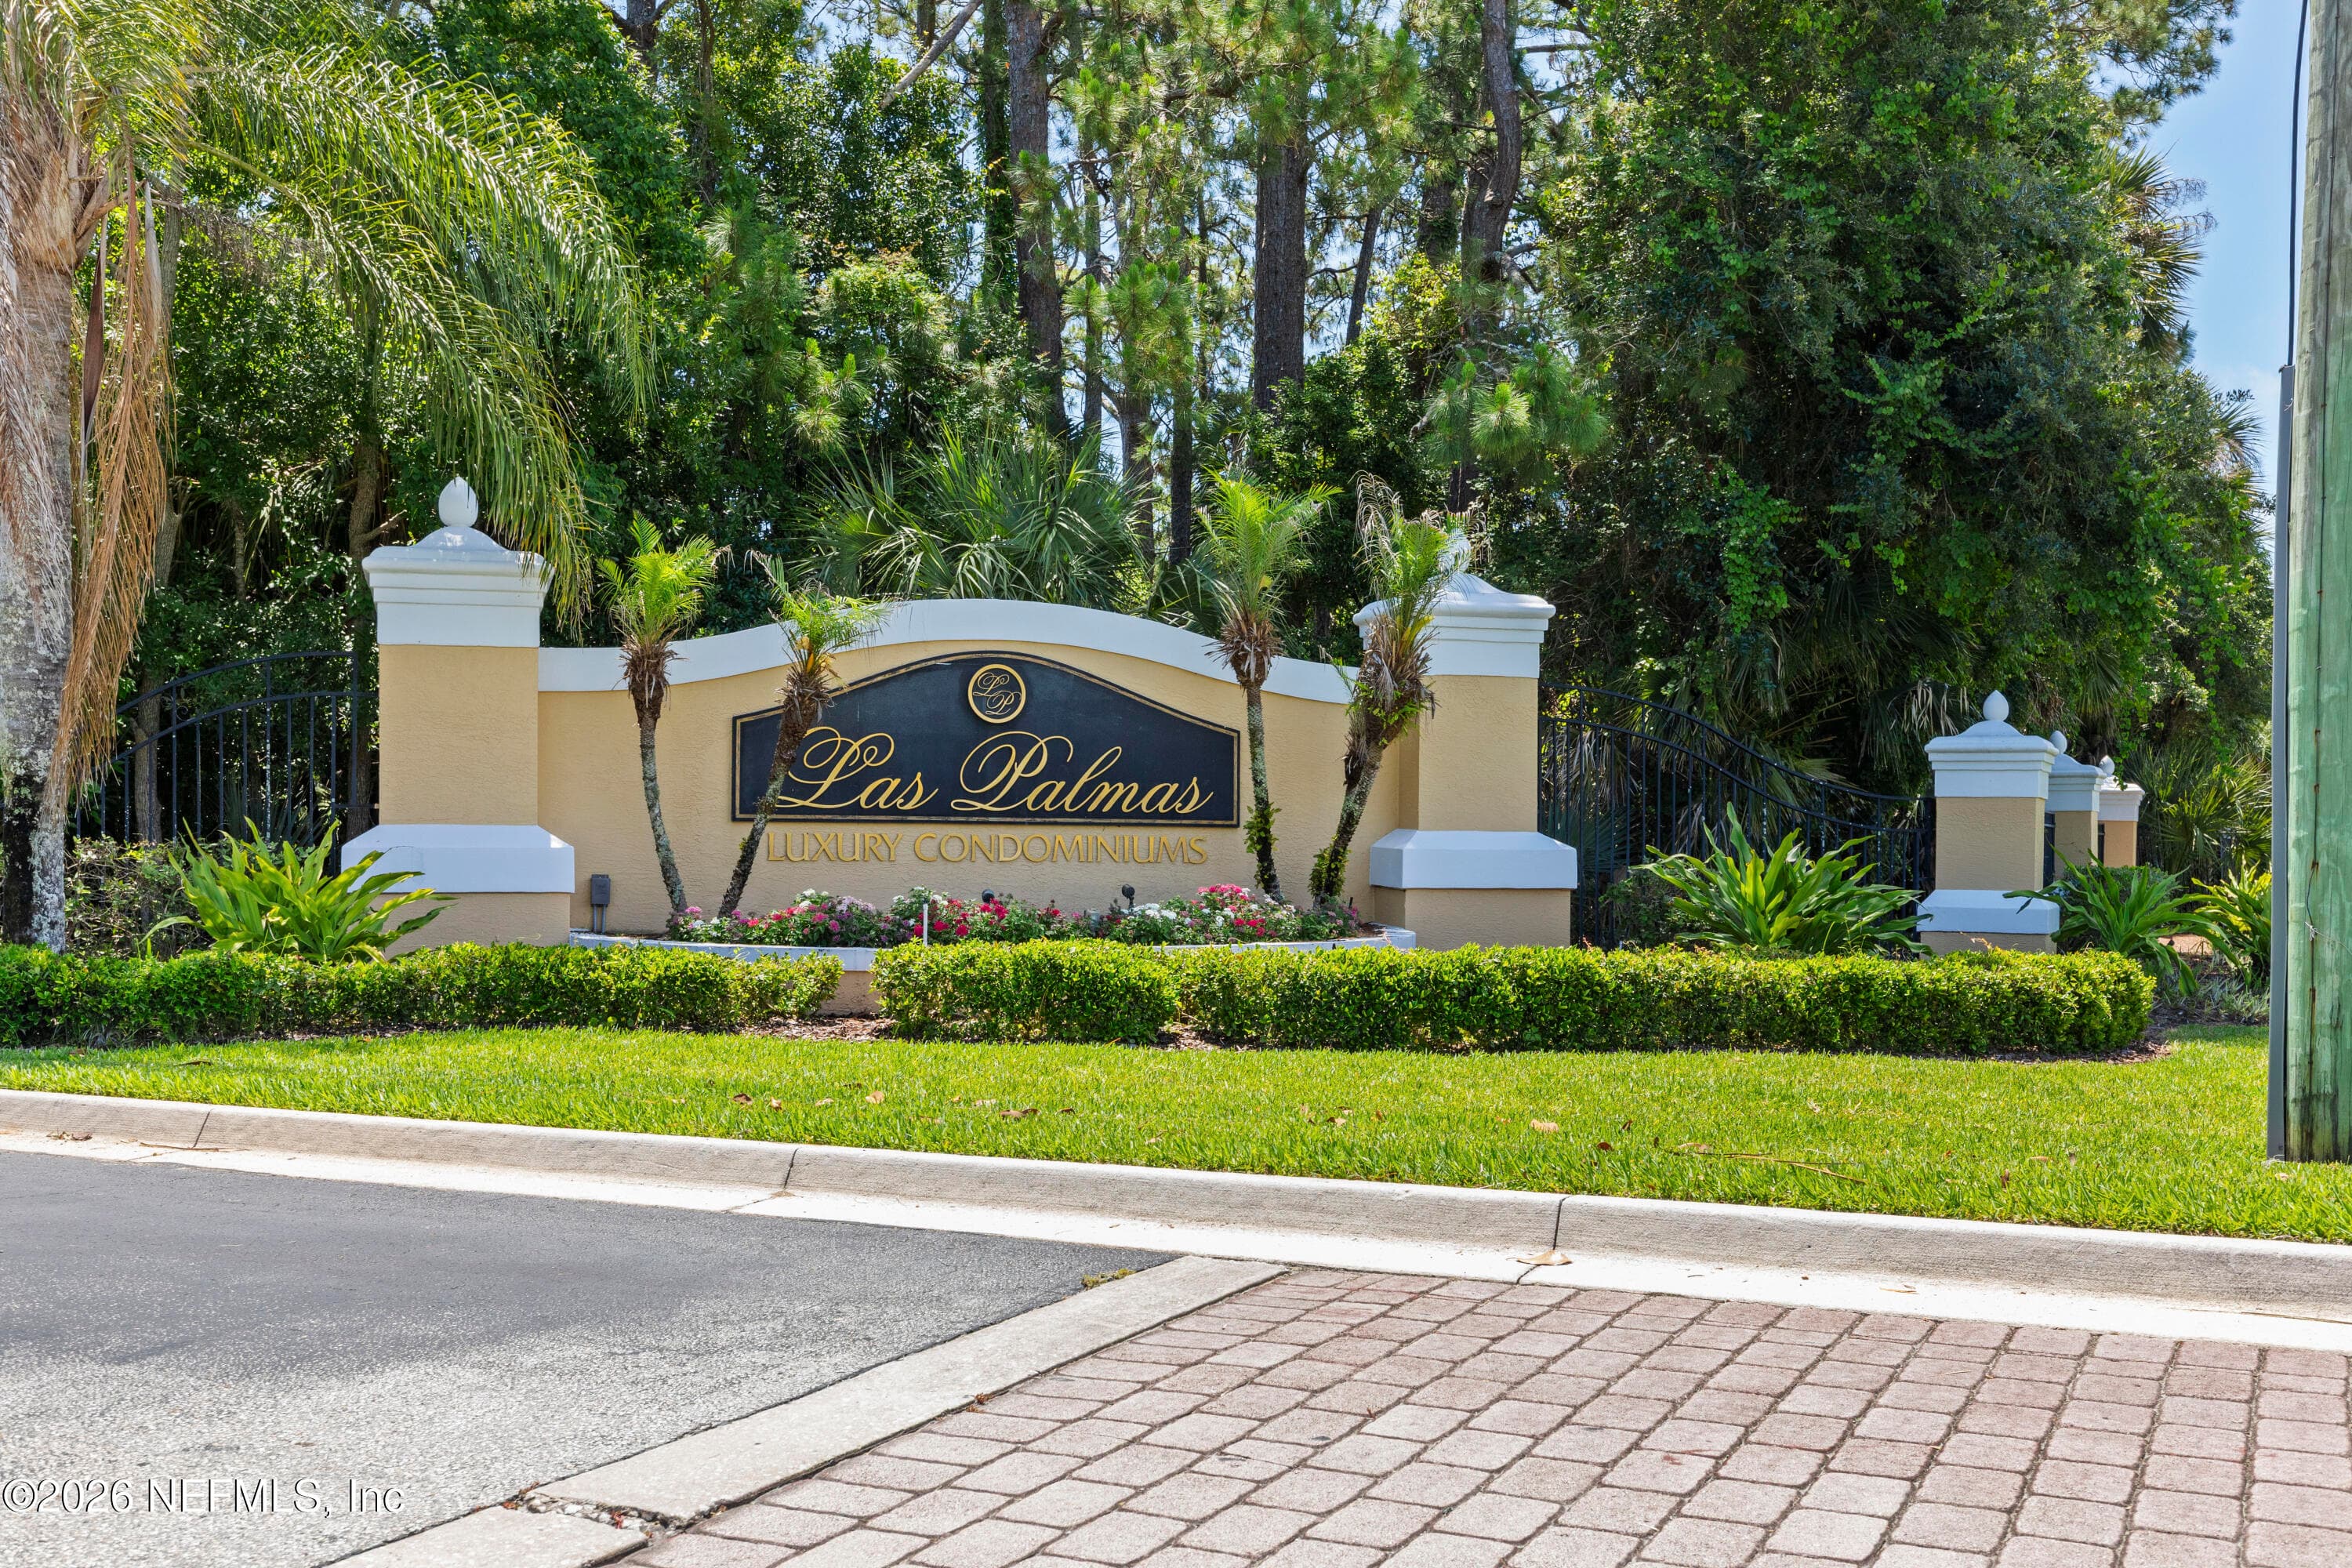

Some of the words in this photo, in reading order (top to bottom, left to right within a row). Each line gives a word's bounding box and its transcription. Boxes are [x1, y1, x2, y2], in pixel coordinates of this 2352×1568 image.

[775, 726, 938, 810] Las
[951, 731, 1213, 814] Palmas
[767, 832, 902, 862] LUXURY
[913, 832, 1208, 864] CONDOMINIUMS
